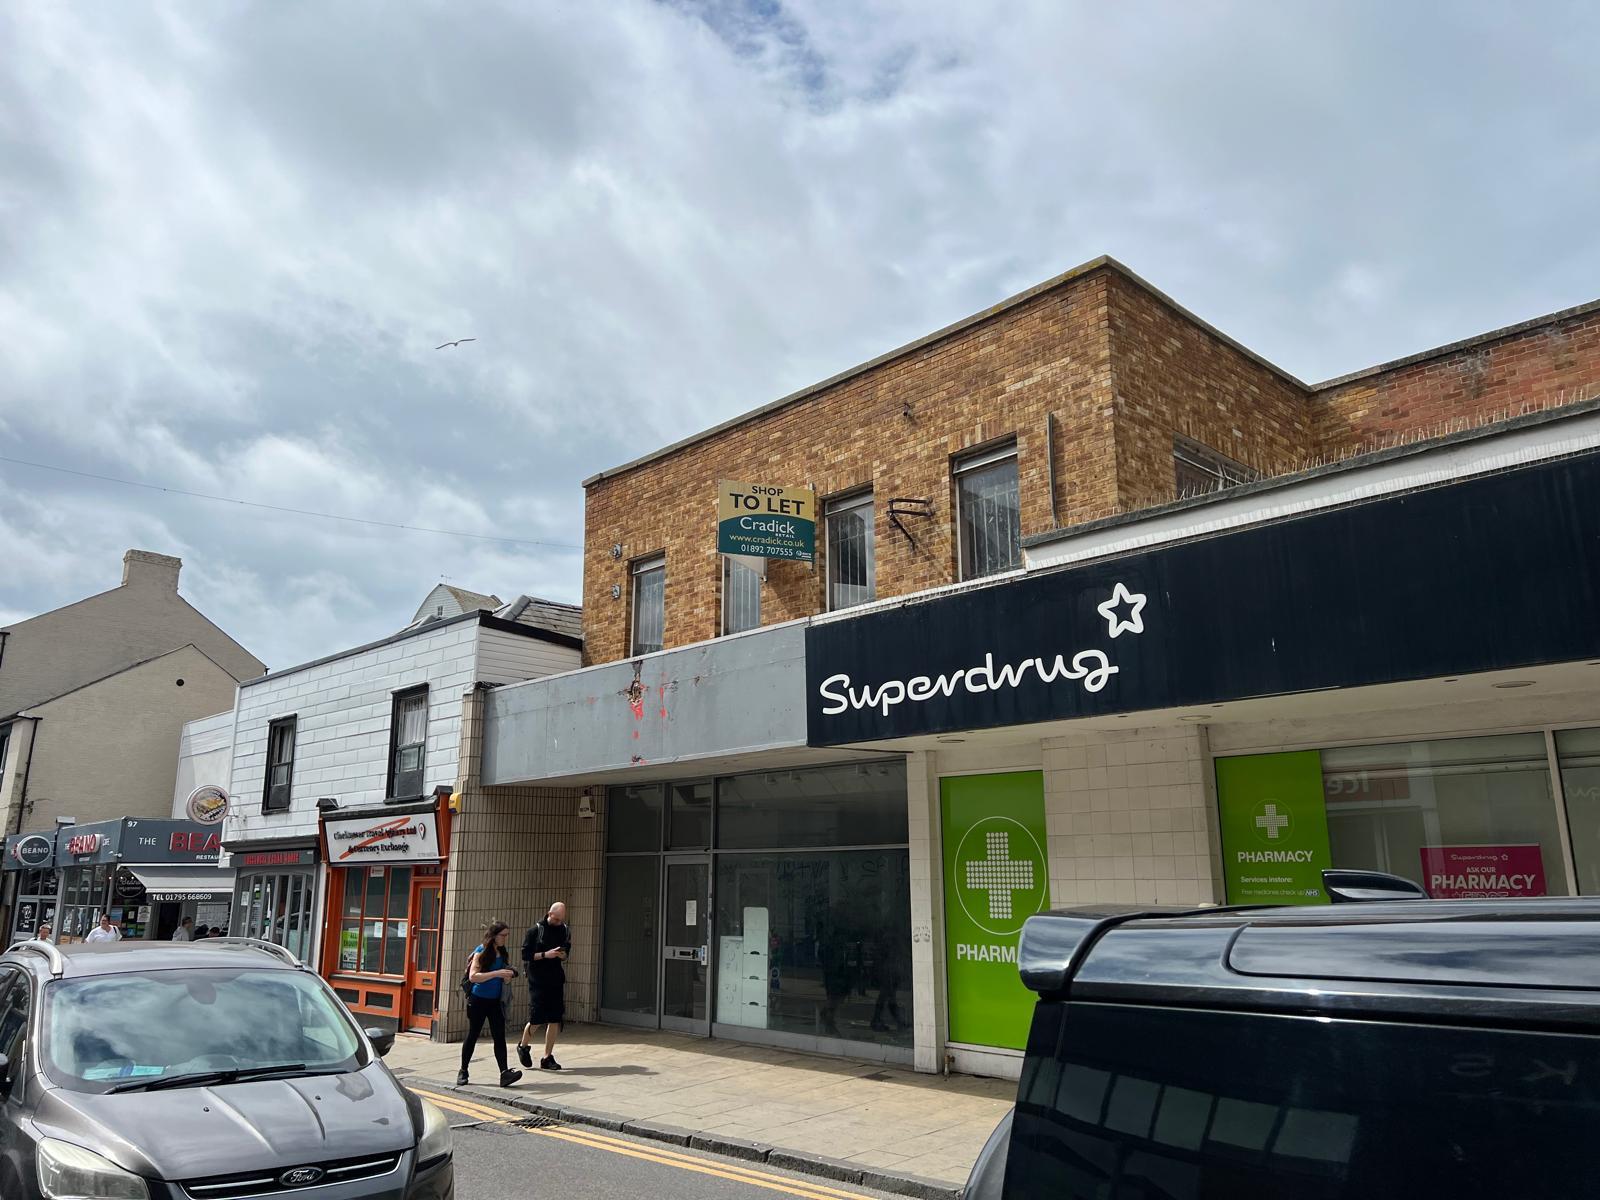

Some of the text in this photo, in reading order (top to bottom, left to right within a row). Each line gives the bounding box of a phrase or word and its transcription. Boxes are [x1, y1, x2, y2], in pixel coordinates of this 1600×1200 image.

[752, 485, 784, 497] SHOP
[729, 493, 805, 515] TO LET
[740, 516, 795, 535] Cradick
[729, 534, 805, 548] www.cradick.co.uk
[741, 544, 764, 554] 01892
[766, 546, 793, 557] 707555
[820, 649, 1119, 717] Superdrug
[138, 837, 157, 846] THE
[381, 842, 409, 853] Exchange
[21, 846, 49, 855] BEANO
[1237, 850, 1314, 863] PHARMACY
[1450, 853, 1498, 862] Superdrug
[1240, 876, 1268, 884] Services
[1431, 874, 1536, 890] PHARMACY
[165, 893, 187, 901] 01795
[956, 943, 1018, 964] PHARM
[290, 1169, 315, 1183] Ford
